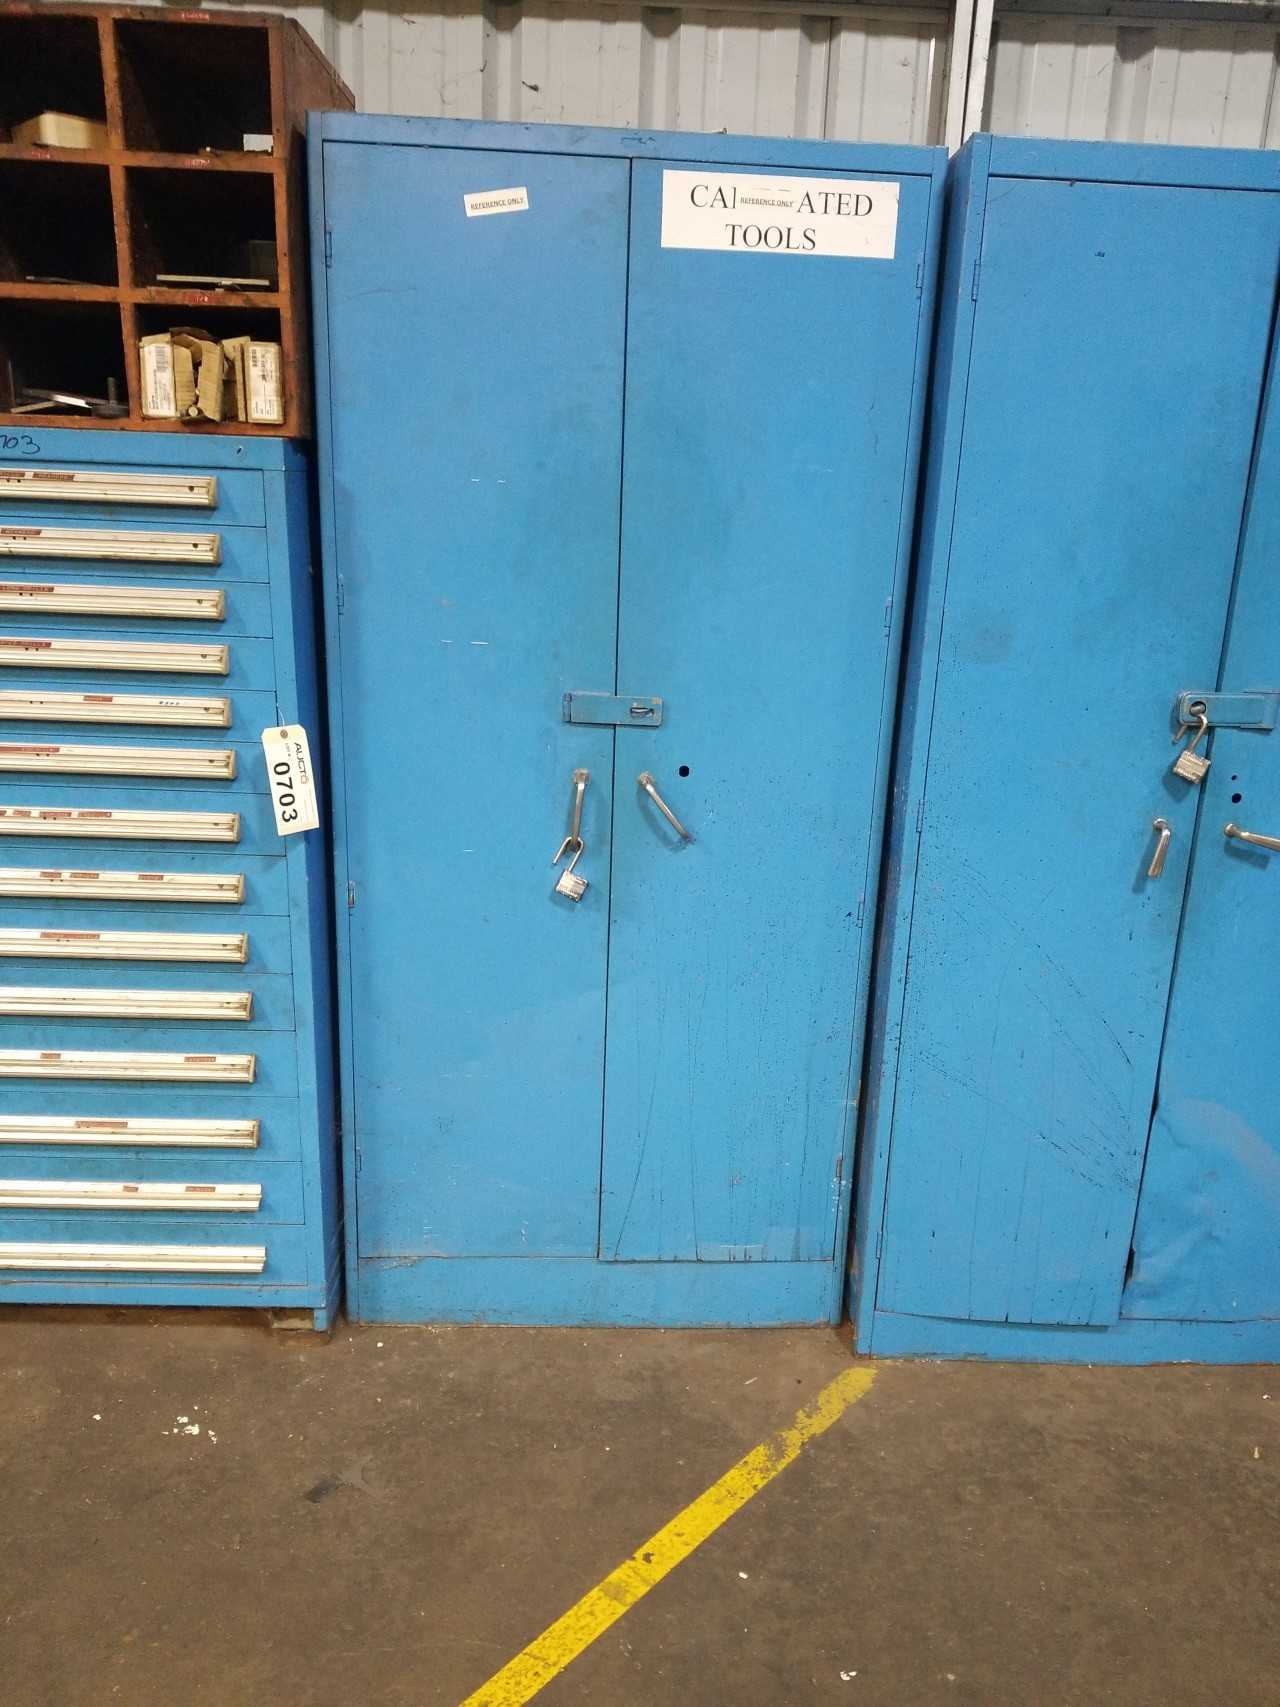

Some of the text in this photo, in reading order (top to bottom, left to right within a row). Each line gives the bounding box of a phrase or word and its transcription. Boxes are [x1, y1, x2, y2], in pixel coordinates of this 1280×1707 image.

[470, 197, 524, 209] REFERENCE ONLY
[740, 196, 794, 208] REFERENCE ONLY
[725, 224, 817, 250] TOOLS
[273, 762, 298, 823] 0703
